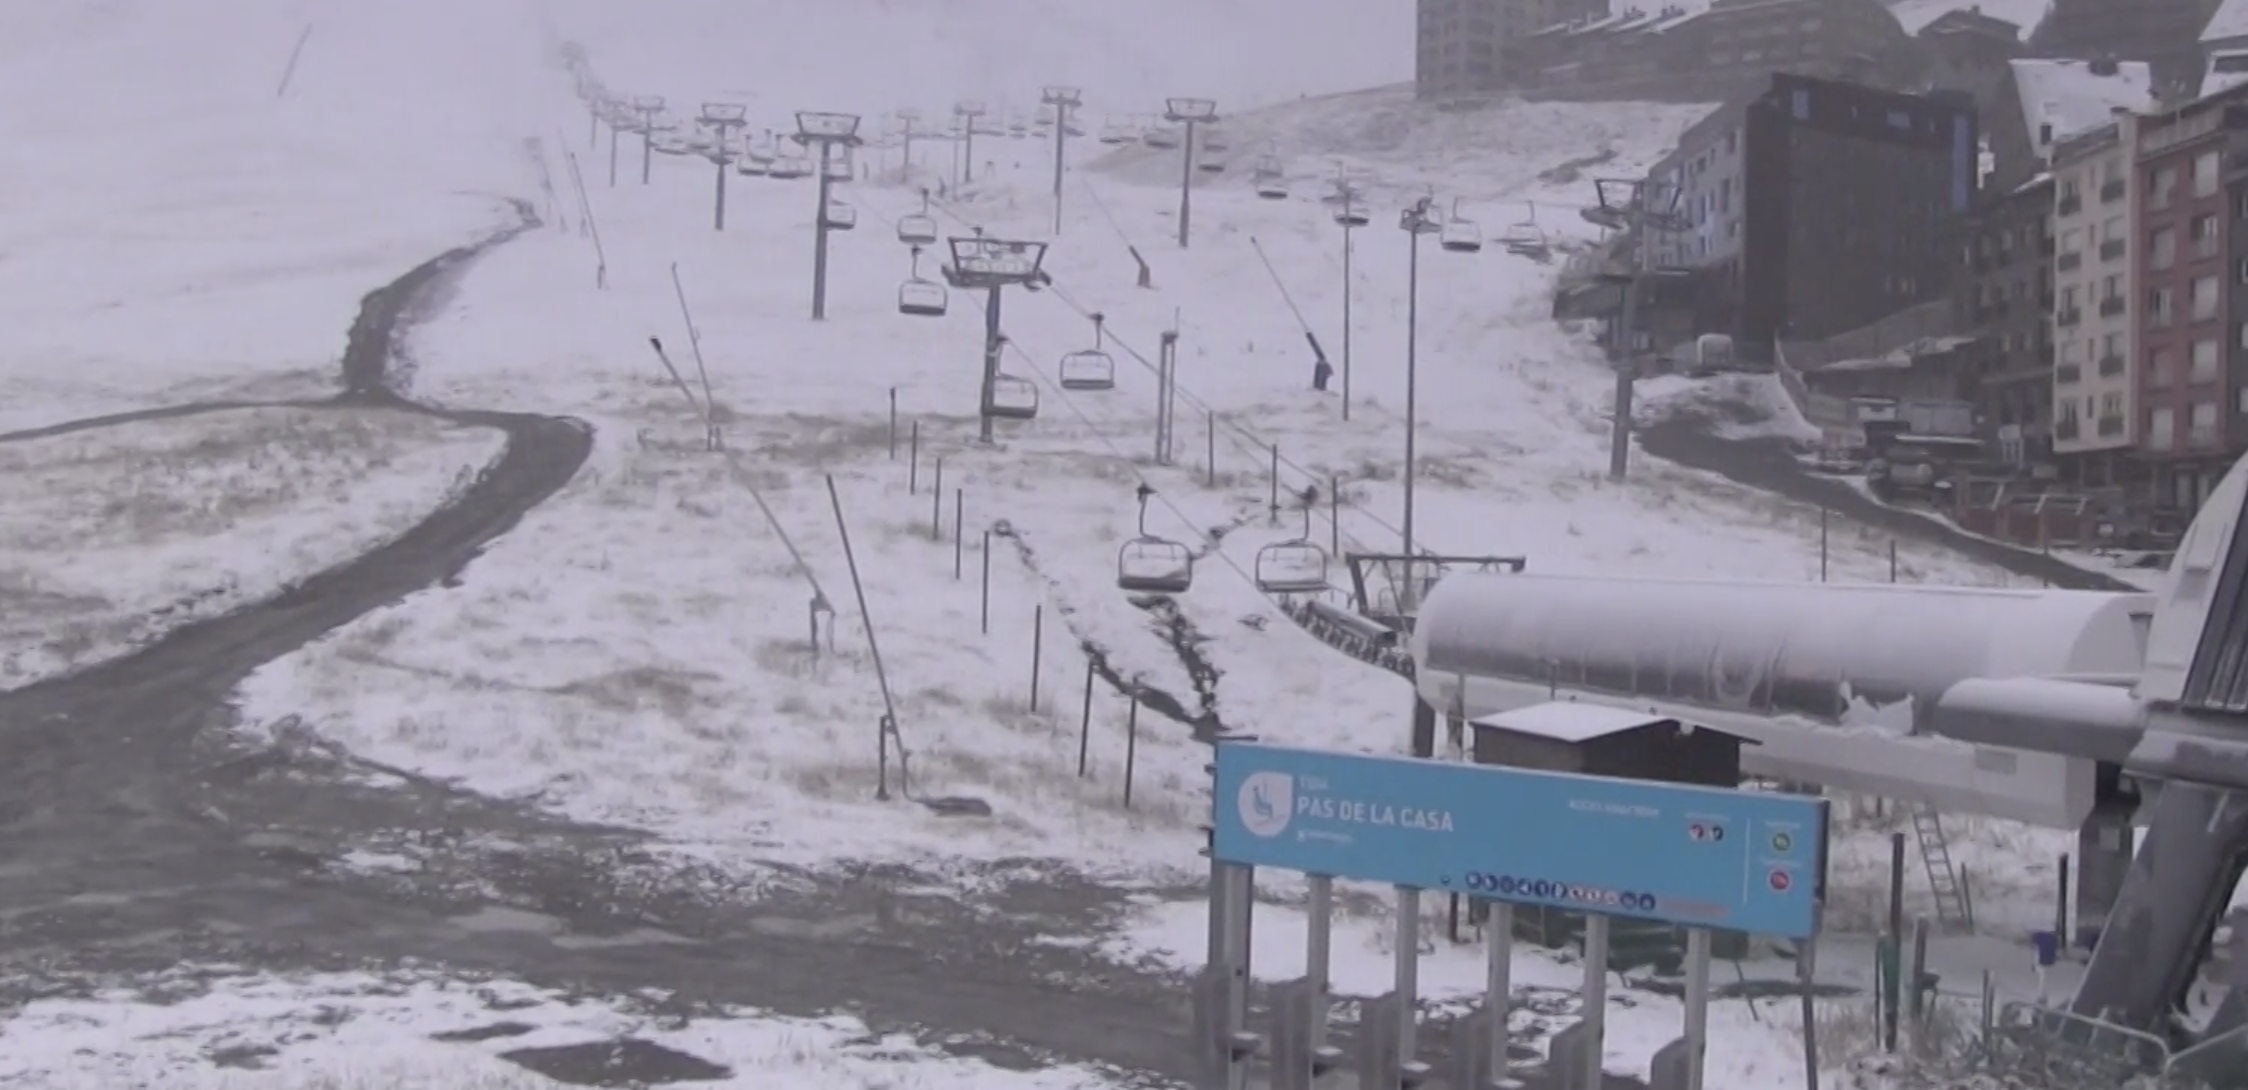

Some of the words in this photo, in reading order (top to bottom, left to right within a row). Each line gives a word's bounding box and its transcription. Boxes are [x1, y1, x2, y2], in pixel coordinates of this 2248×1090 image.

[1297, 796, 1335, 818] PAS
[1339, 799, 1366, 823] DE
[1370, 803, 1395, 825] LA
[1400, 807, 1454, 832] CASA
